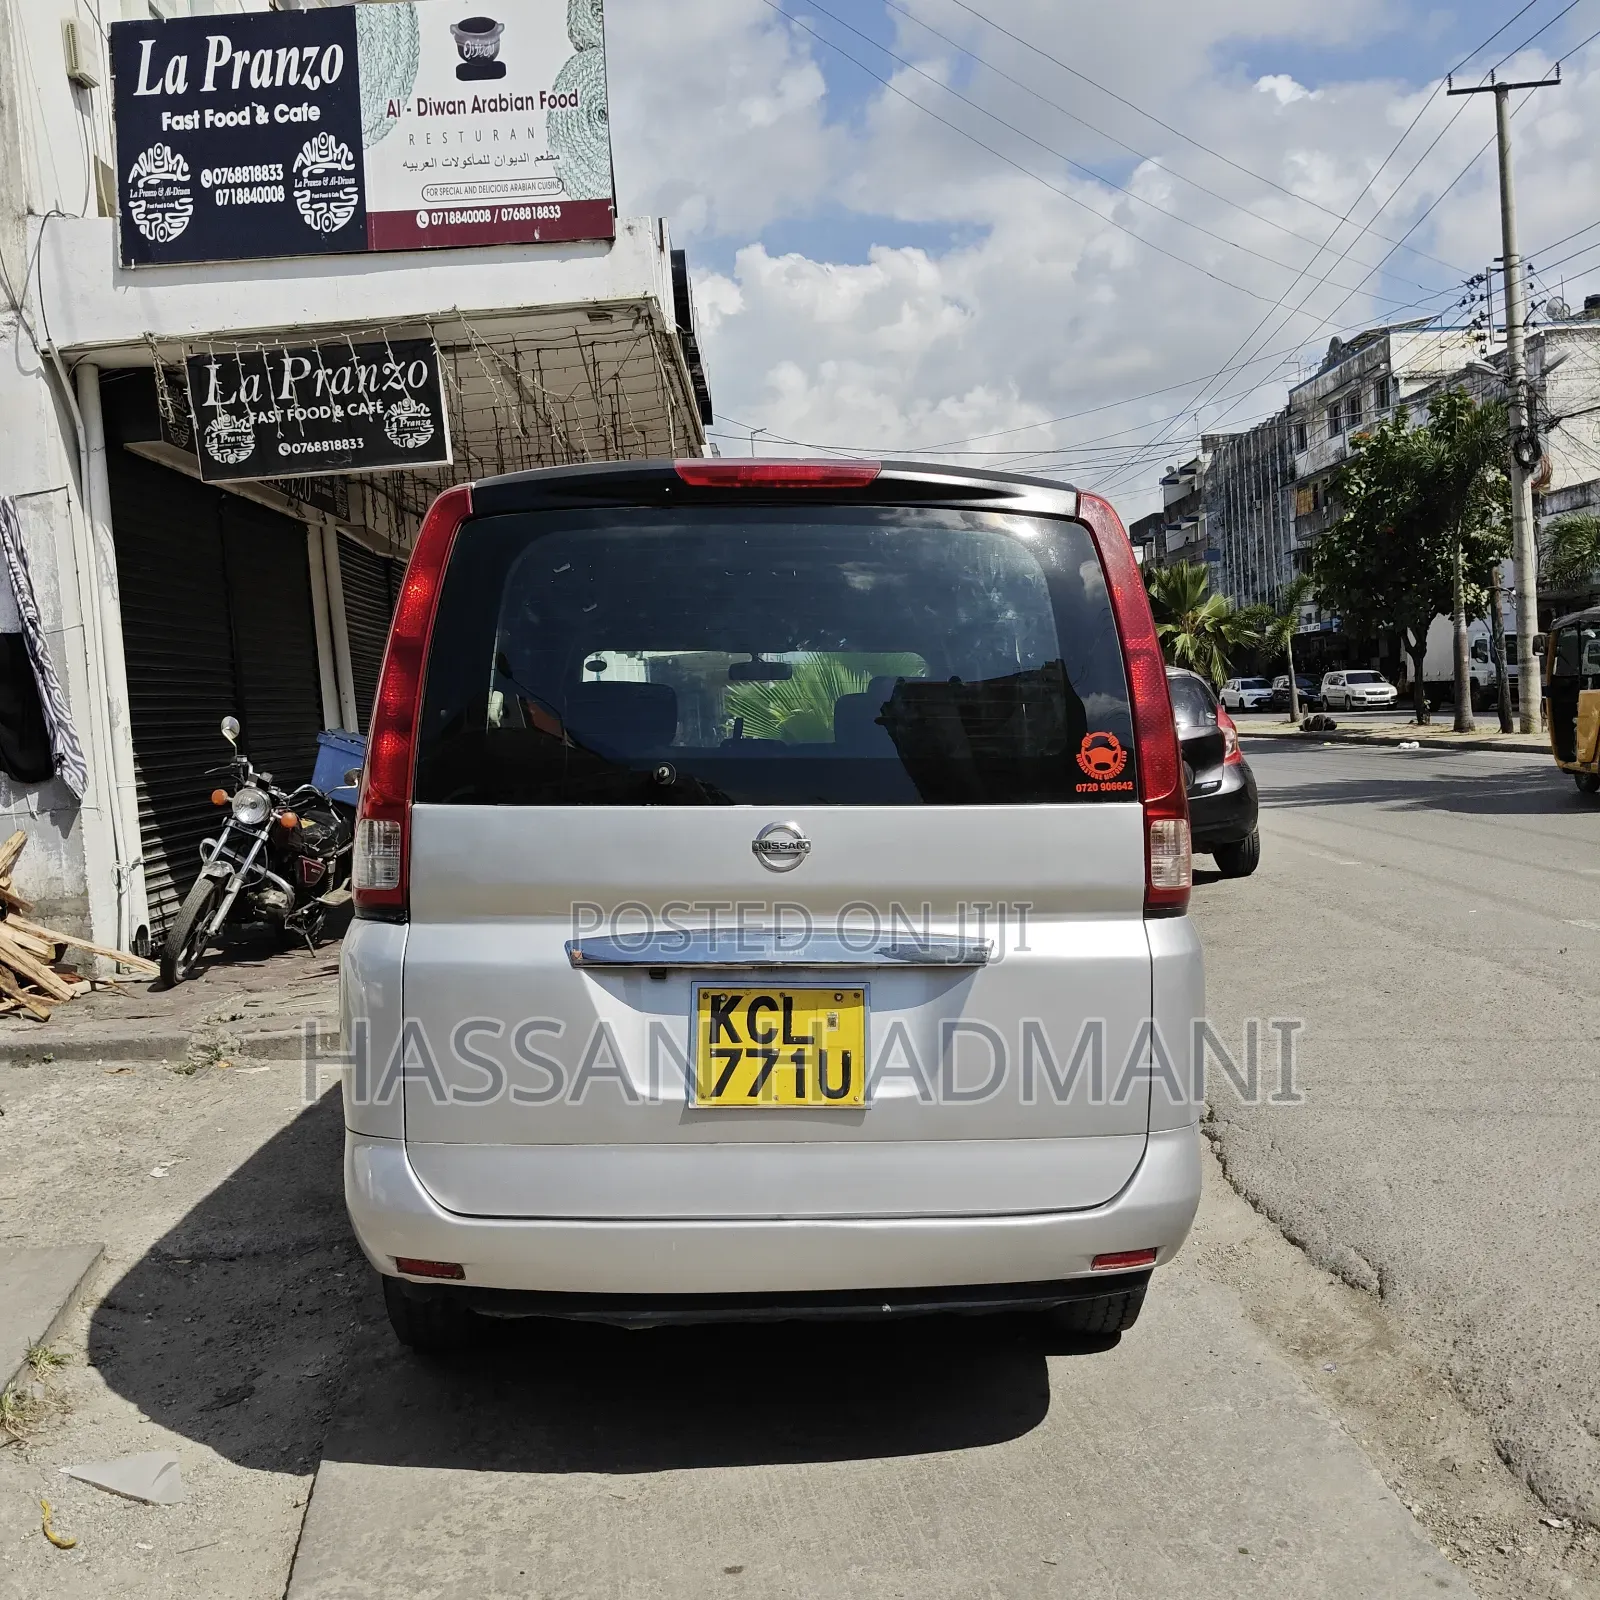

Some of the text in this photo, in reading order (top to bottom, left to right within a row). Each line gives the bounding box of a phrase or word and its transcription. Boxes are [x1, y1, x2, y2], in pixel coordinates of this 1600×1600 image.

[133, 35, 344, 96] La Pranzo
[386, 99, 400, 118] Al
[416, 97, 466, 118] Diwan
[471, 92, 534, 114] Arabian
[539, 88, 579, 110] Food
[162, 102, 320, 131] Fast Food & Cafe
[494, 152, 530, 168] الديوان
[533, 150, 560, 168] مطعم
[212, 164, 284, 184] 0768818833
[216, 185, 286, 206] 0718840008
[426, 180, 560, 197] FOR SPECIAL AND DELICIOUS ARABIAN CUISINE
[432, 209, 491, 225] 0718840008
[501, 204, 561, 222] 0768818833
[202, 357, 428, 406] La Pranzo
[250, 409, 285, 426] FAST
[287, 405, 331, 422] FOOD
[335, 404, 344, 416] &
[400, 419, 431, 428] Pranzo
[220, 434, 253, 443] Pranzo
[292, 438, 364, 454] 0768818833
[1076, 781, 1133, 792] 0720 906642
[758, 842, 806, 850] NISSAN
[709, 995, 815, 1045] KCL
[709, 1048, 852, 1100] 771U
